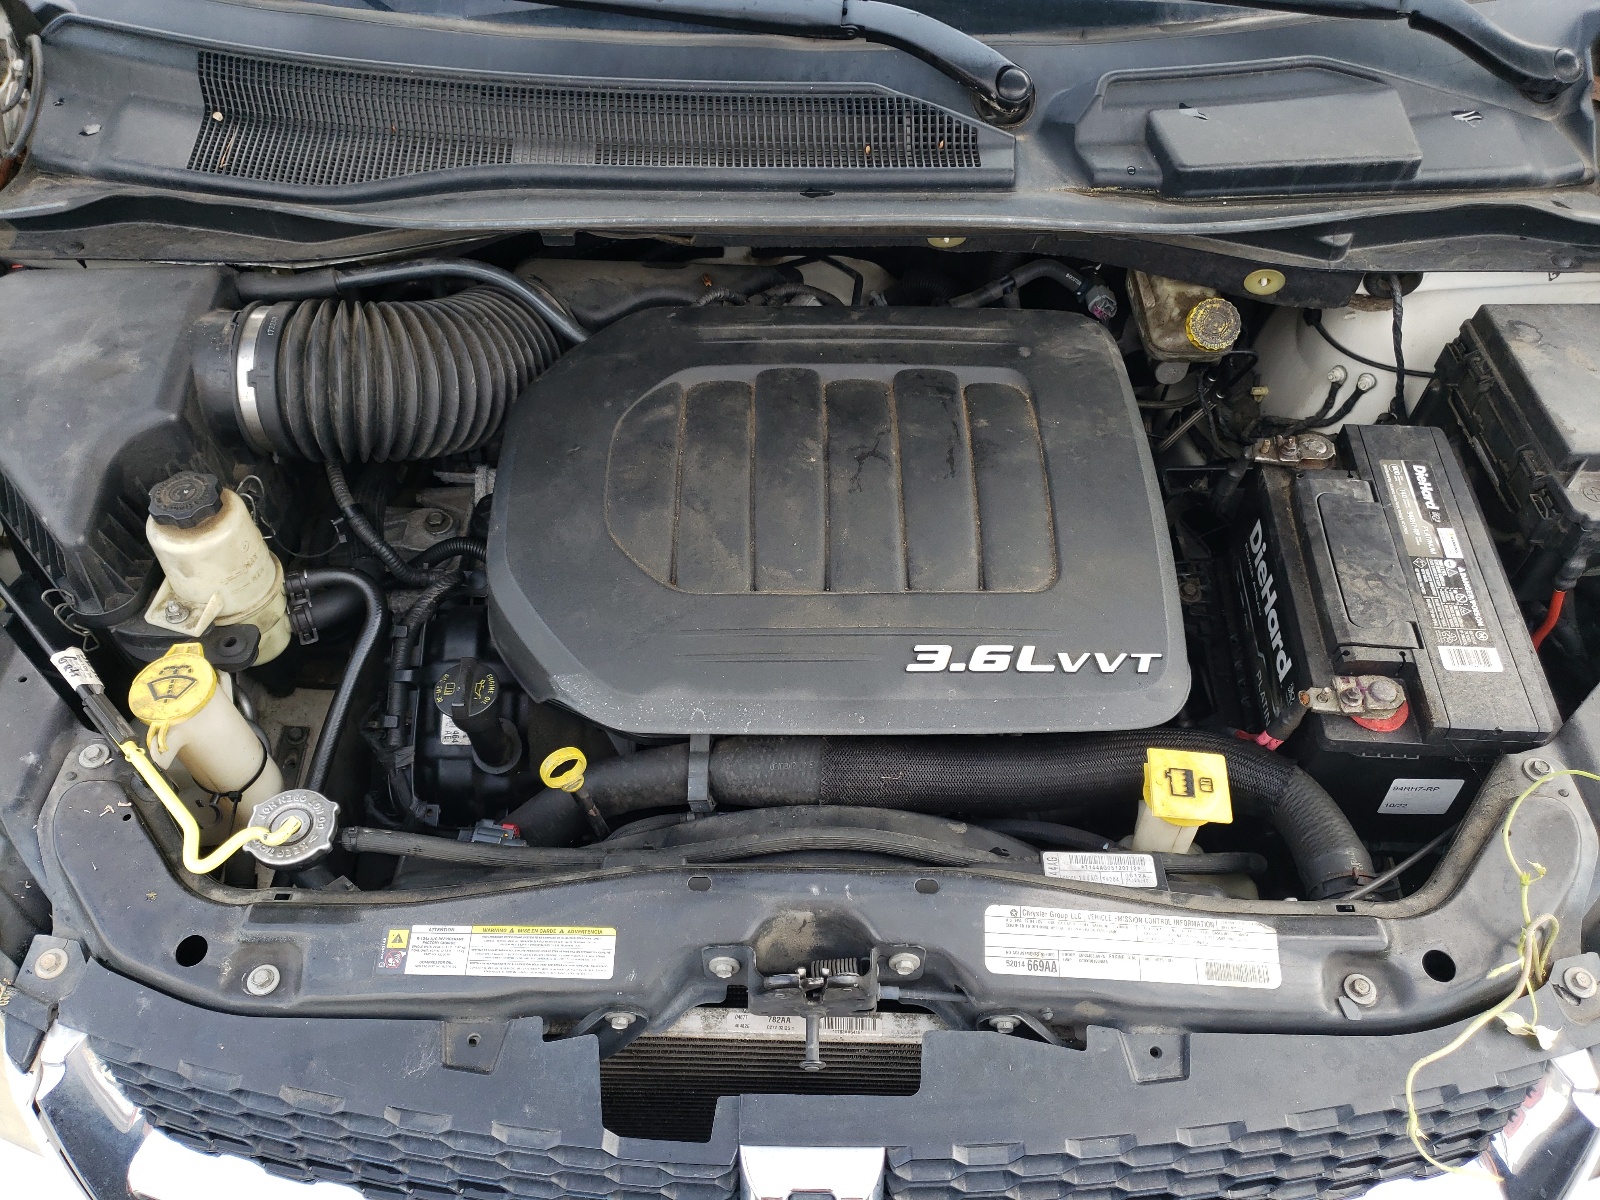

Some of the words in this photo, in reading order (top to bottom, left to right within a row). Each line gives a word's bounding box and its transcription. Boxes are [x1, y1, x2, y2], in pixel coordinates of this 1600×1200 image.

[1412, 464, 1440, 511] DieHard
[1249, 518, 1293, 683] DieHard
[905, 644, 1056, 673] 3.6L
[1056, 652, 1163, 674] VVT
[486, 673, 496, 695] ENGINE
[480, 696, 491, 705] OIL
[1255, 668, 1271, 727] PLATIN
[278, 795, 307, 805] OPEN
[258, 801, 278, 820] HOT
[1022, 909, 1048, 918] Chrysler
[1049, 911, 1069, 920] Group
[1070, 912, 1082, 920] LLC
[1144, 917, 1172, 926] CONTROL
[1173, 919, 1215, 928] INFORMATION
[1005, 959, 1026, 968] 52014
[1027, 959, 1058, 973] 669AA
